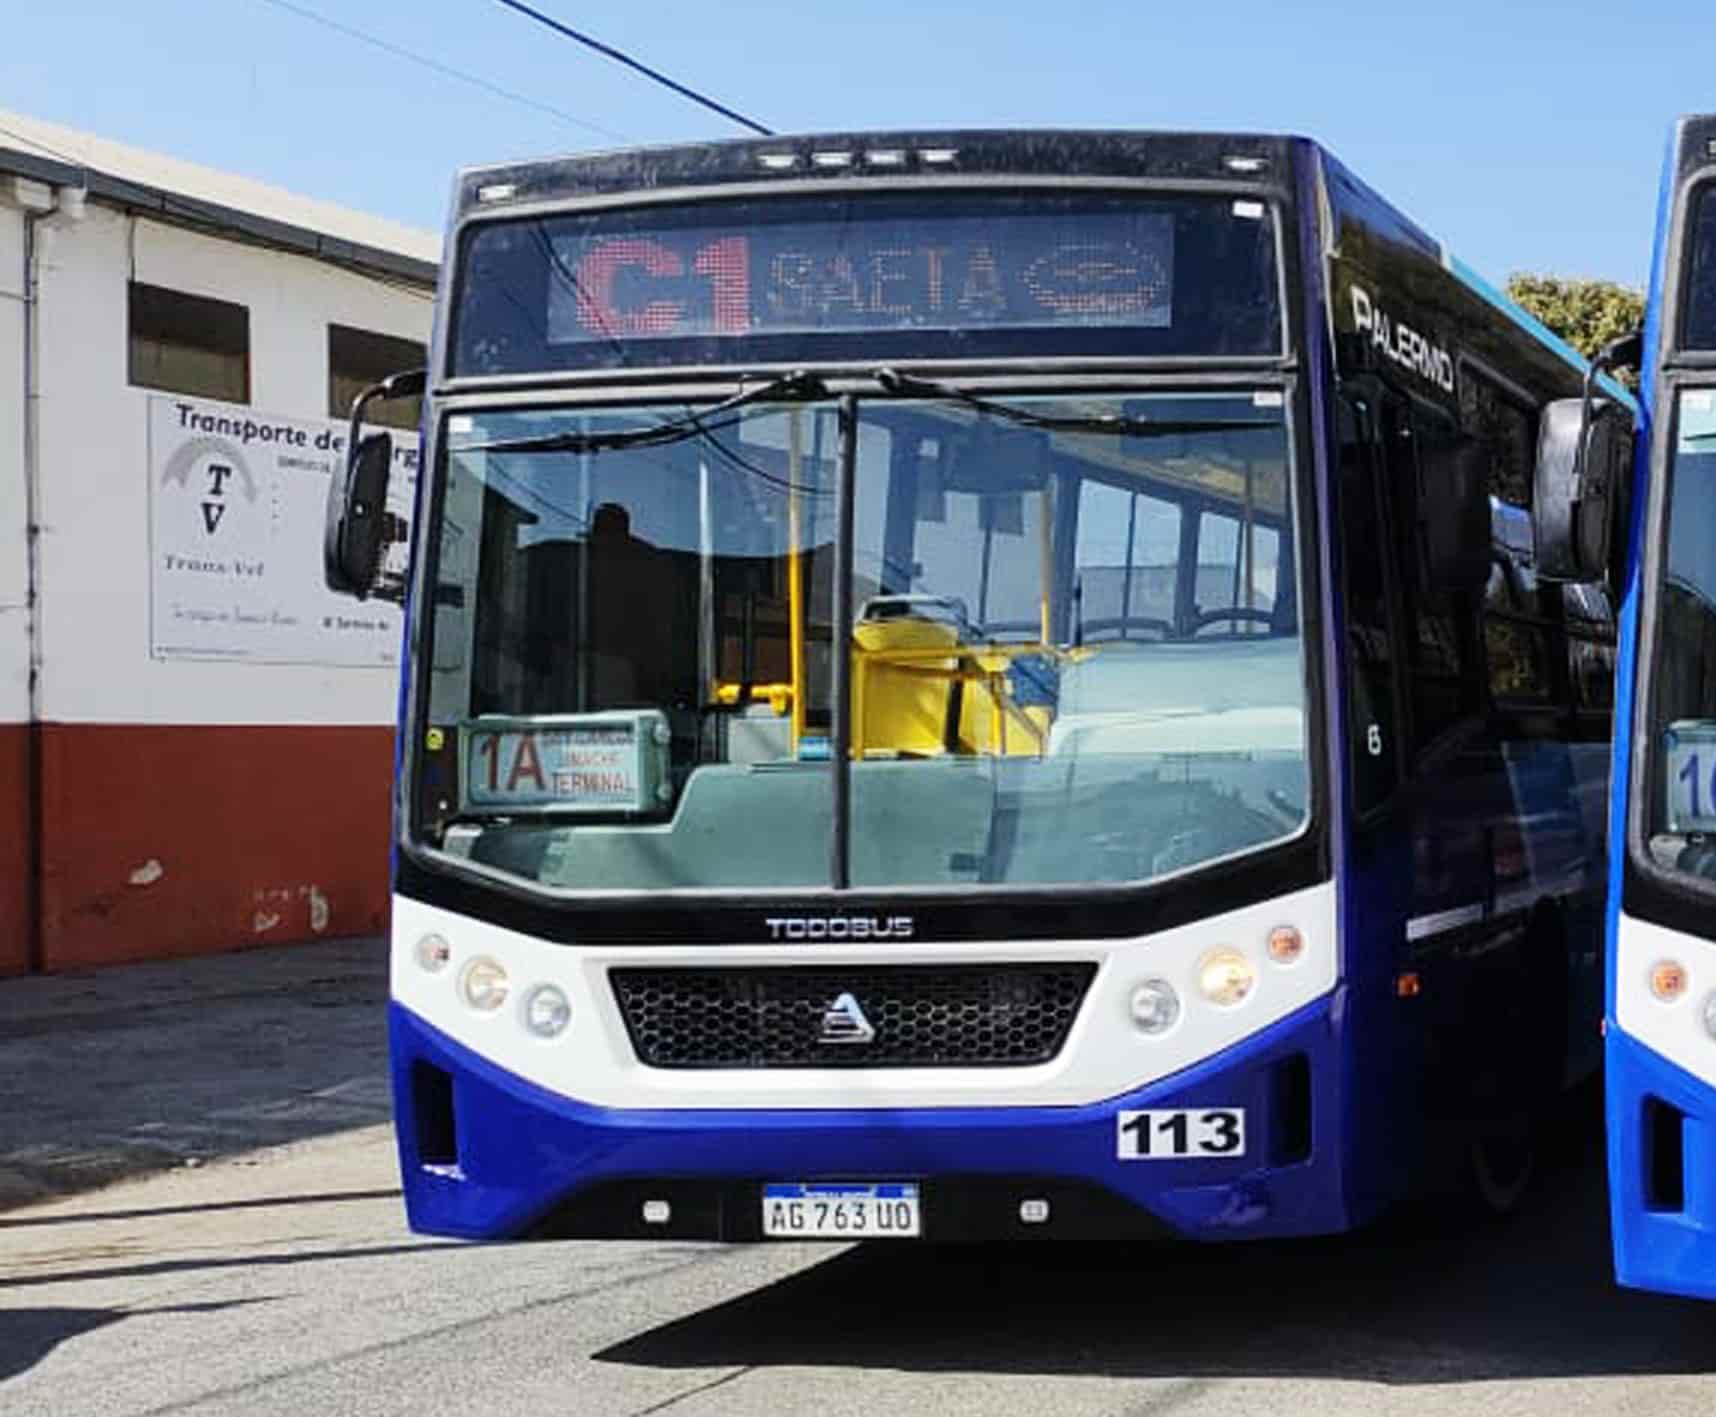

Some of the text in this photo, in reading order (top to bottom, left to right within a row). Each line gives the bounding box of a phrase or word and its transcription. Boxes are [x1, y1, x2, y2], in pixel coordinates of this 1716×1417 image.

[575, 238, 1008, 337] C1 SAETA
[1350, 284, 1454, 393] PALERMO
[175, 402, 307, 447] Transporte
[208, 464, 232, 496] T
[202, 502, 226, 535] V
[479, 731, 547, 792] 1A
[552, 771, 636, 794] TERMINAL
[765, 917, 914, 939] TODOBUS
[1122, 1111, 1241, 1154] 113
[772, 1202, 805, 1230] AG
[814, 1202, 867, 1230] 763
